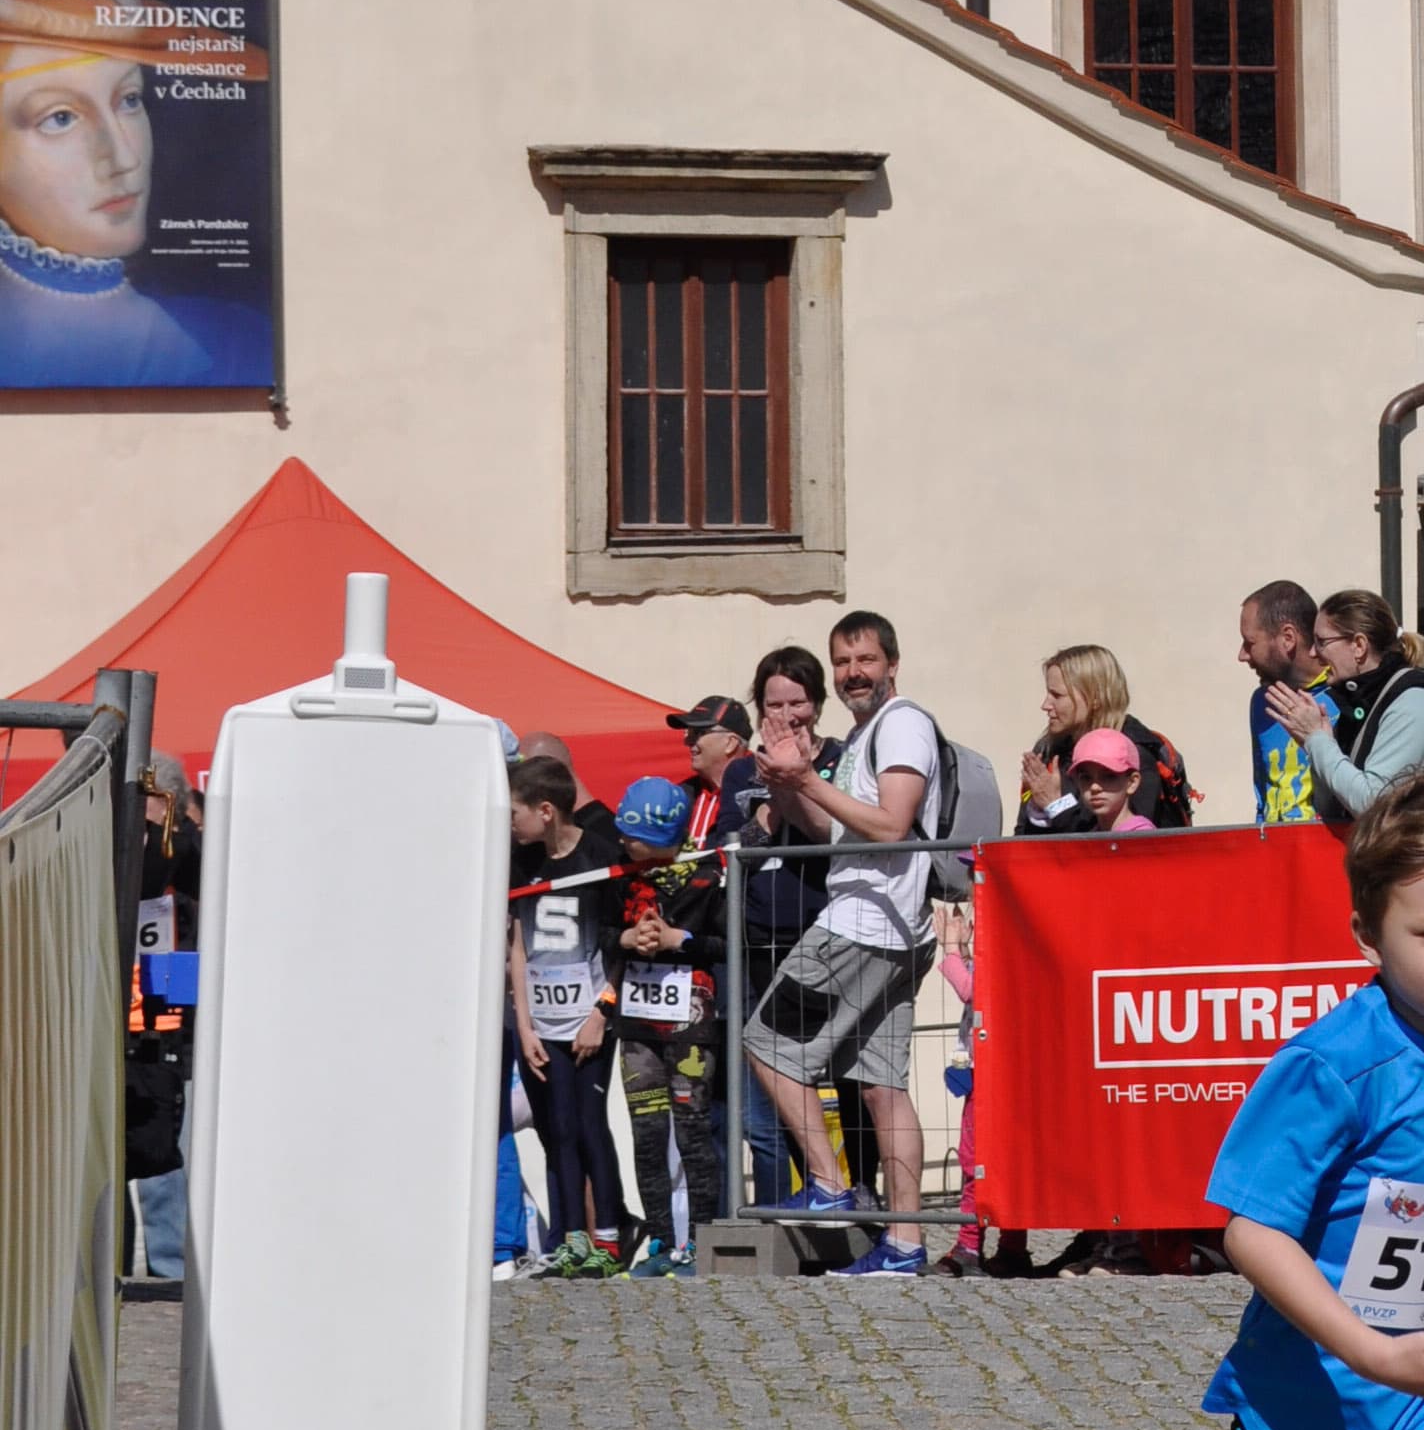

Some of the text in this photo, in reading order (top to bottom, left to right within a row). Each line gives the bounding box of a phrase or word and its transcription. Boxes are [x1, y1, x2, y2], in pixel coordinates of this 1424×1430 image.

[95, 5, 246, 29] REZIDENCE
[168, 36, 246, 55] nejstarší
[155, 62, 246, 77] renesance
[155, 80, 247, 101] v Čechách
[533, 895, 580, 951] S
[533, 983, 583, 1005] 5107
[629, 981, 680, 1005] 2138
[1113, 982, 1369, 1044] NUTRE
[1101, 1082, 1247, 1104] THE POWER
[1363, 1305, 1397, 1319] PVZP
